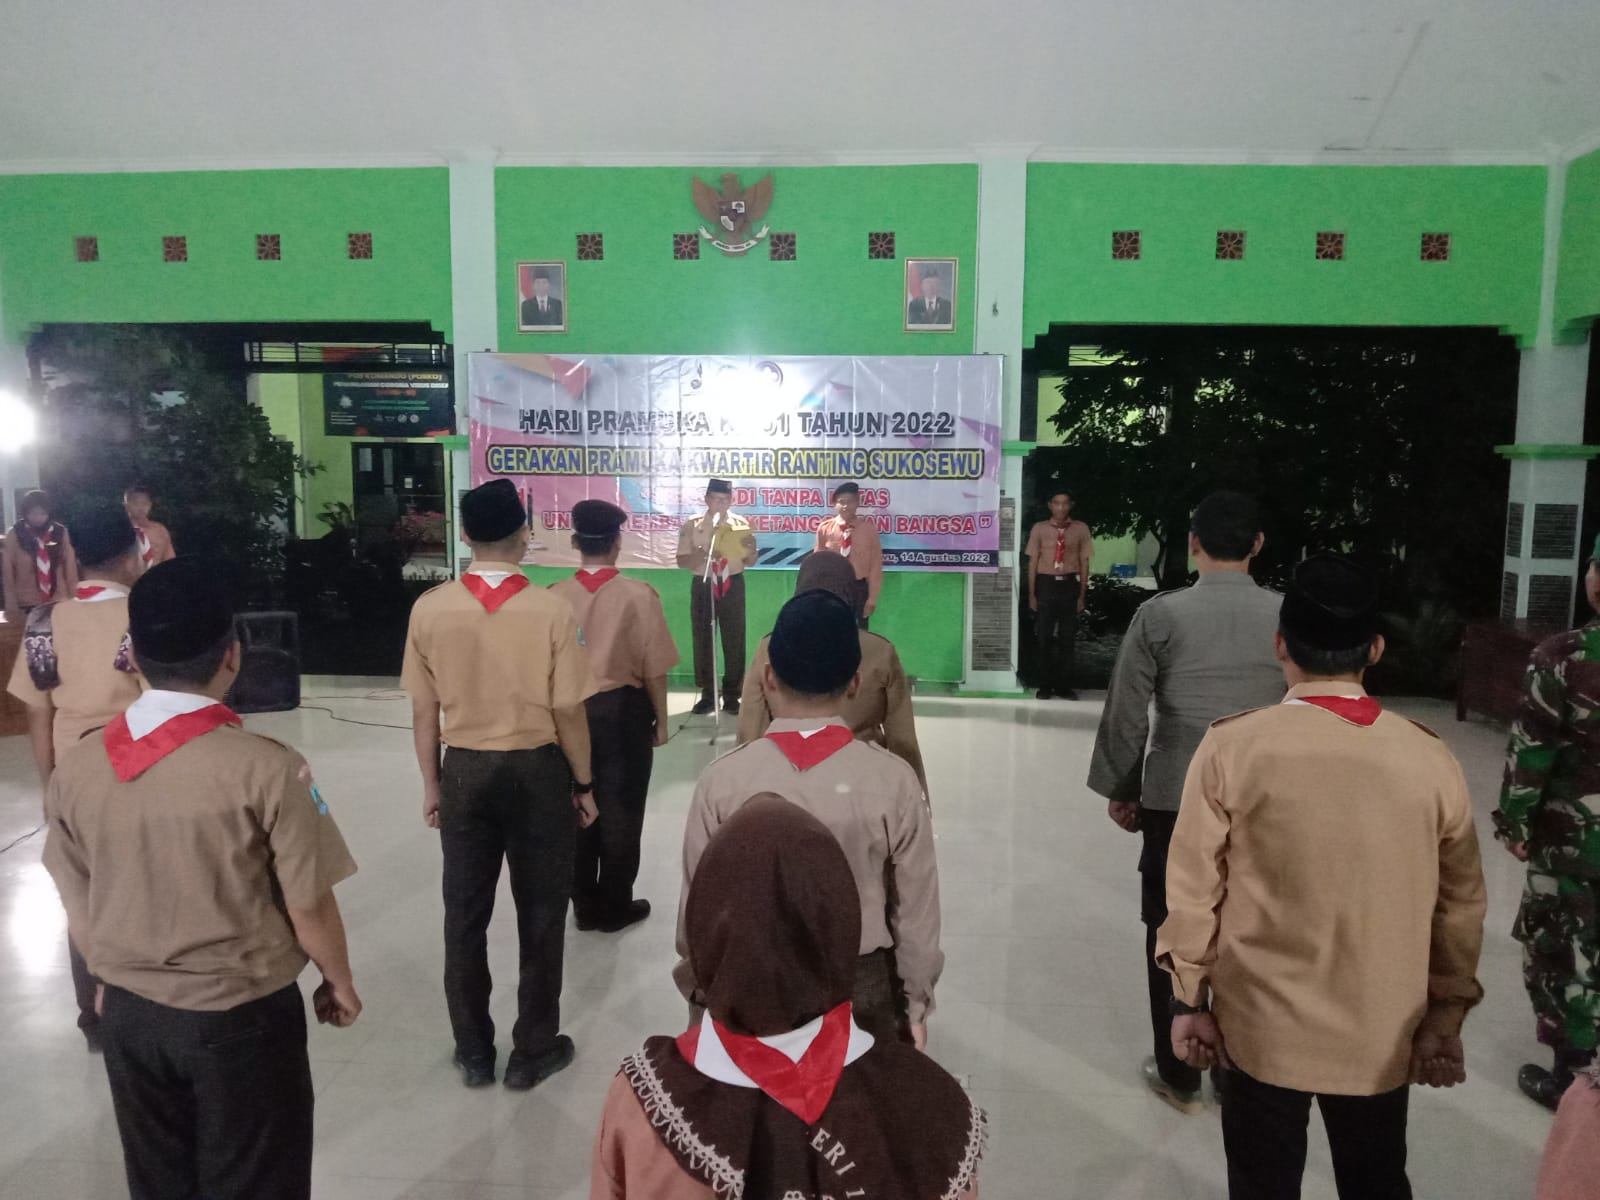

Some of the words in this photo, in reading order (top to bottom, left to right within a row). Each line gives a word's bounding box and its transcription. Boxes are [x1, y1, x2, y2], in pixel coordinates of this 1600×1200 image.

[520, 409, 580, 432] HARI
[798, 412, 883, 434] TAHUN
[891, 412, 953, 434] 2022
[490, 449, 581, 472] GERAKAN
[687, 452, 774, 474] KWARTIR
[780, 452, 865, 475] RANTING
[870, 452, 981, 476] SUKOSEWU
[761, 488, 823, 507] TANPA
[896, 516, 976, 534] BANGSA
[901, 552, 915, 562] 14
[917, 552, 961, 564] Agustus
[962, 552, 989, 563] 2022
